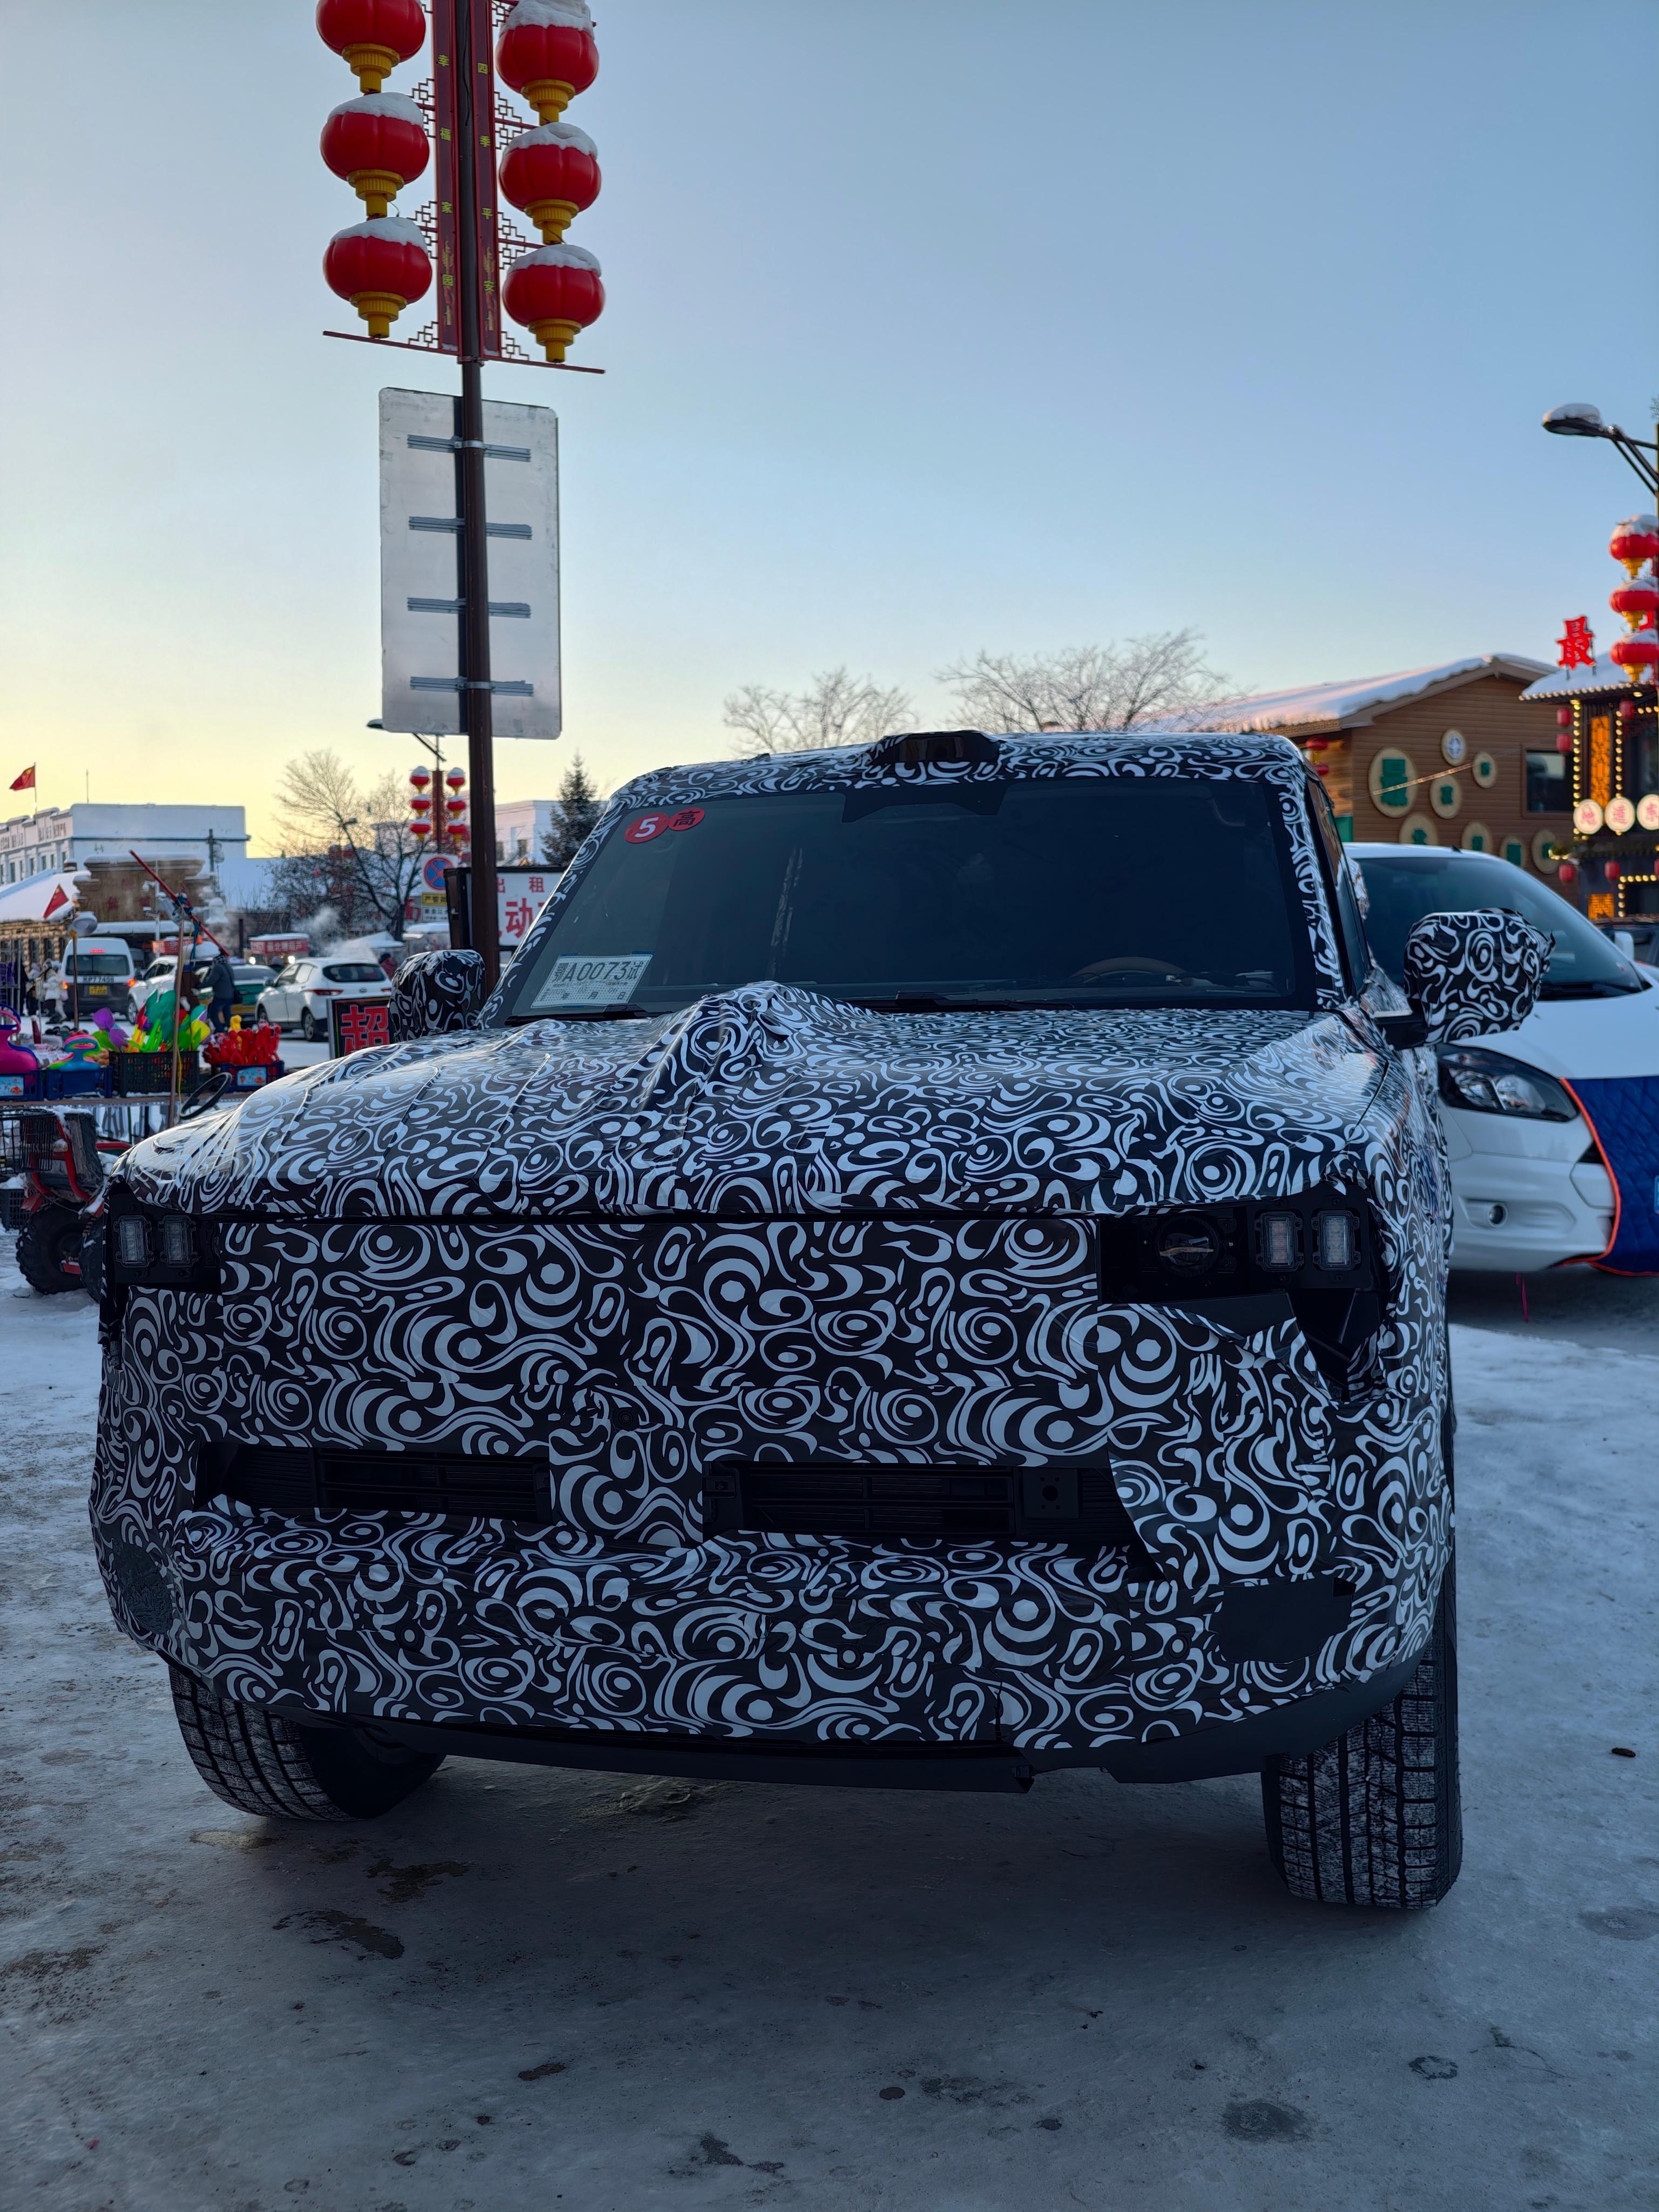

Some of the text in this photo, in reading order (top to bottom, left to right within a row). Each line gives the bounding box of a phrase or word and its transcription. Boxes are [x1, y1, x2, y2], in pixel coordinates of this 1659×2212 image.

[437, 54, 454, 287] 幸福家园
[477, 62, 496, 293] 四季平安
[1556, 615, 1596, 670] 最
[634, 810, 700, 838] 5 高
[552, 960, 644, 982] 鄂A0073试
[341, 1004, 389, 1055] 超
